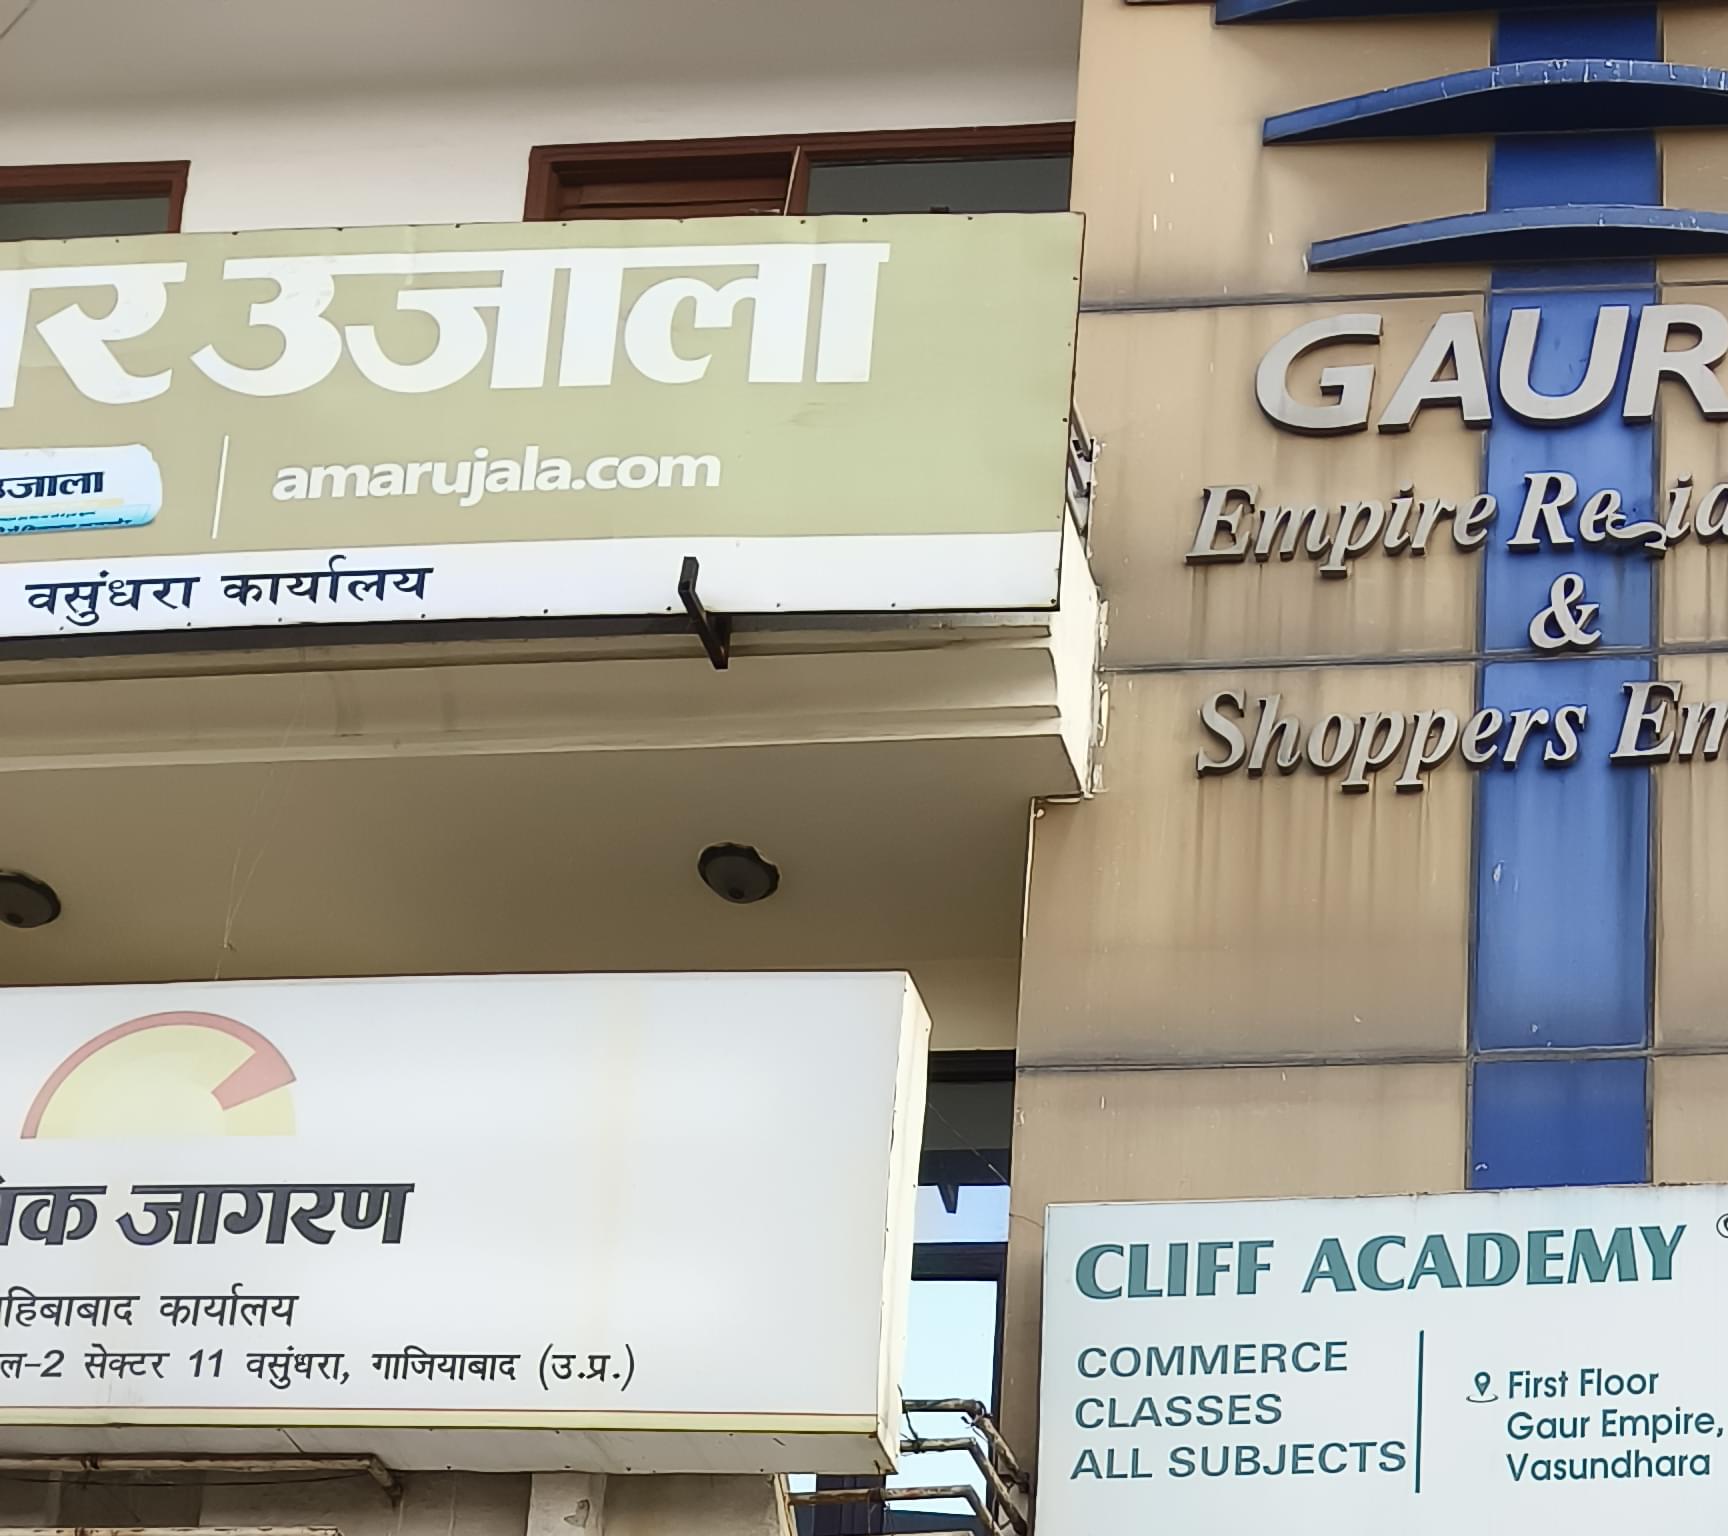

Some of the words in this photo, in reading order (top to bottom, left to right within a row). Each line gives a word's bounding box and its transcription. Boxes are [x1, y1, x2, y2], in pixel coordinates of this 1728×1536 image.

[191, 243, 890, 395] उजाला
[273, 446, 720, 506] amarujala.com
[1187, 481, 1496, 577] Empire
[25, 570, 200, 626] वसुंधरा
[221, 555, 434, 606] कार्यालय
[1530, 574, 1601, 648] &
[1197, 688, 1588, 792] Shoppers
[116, 1183, 415, 1245] जागरण
[1076, 1240, 1274, 1299] CLIFF
[1302, 1225, 1687, 1293] ACADEMY
[160, 1283, 299, 1326] कार्यालय
[85, 1343, 170, 1379] सेक्टर
[190, 1349, 222, 1377] 11
[247, 1346, 349, 1389] वसुंधरा,
[372, 1345, 521, 1381] गाजियाबाद
[540, 1344, 634, 1391] (उ.प्र.)
[1078, 1341, 1347, 1378] COMMERCE
[1076, 1394, 1281, 1428] CLASSES
[1508, 1412, 1590, 1440] Gaur
[1602, 1407, 1723, 1443] Empire,
[1506, 1450, 1710, 1481] Vasundhara
